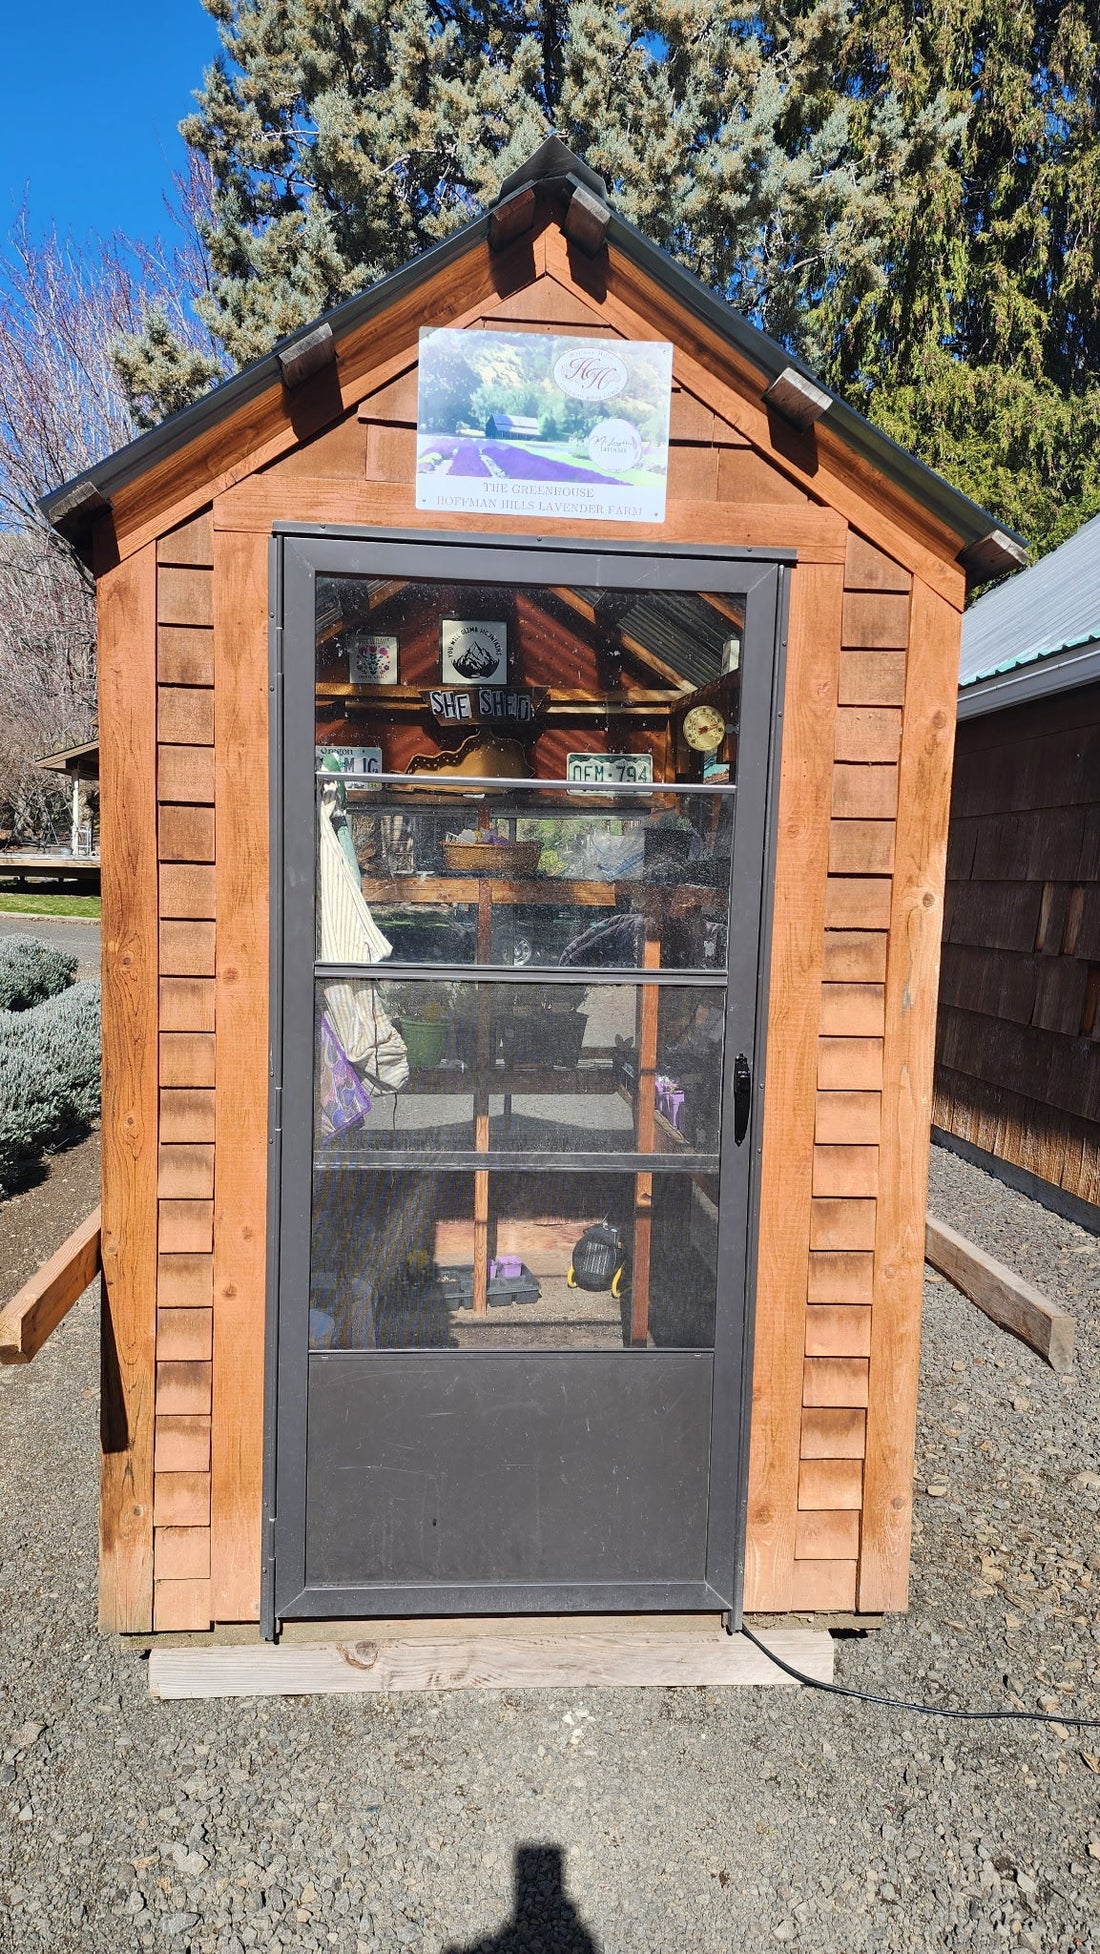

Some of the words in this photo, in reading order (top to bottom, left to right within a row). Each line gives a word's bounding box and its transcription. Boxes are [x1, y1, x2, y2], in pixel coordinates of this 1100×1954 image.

[482, 482, 508, 494] THE
[512, 485, 595, 498] GREENHOUSE
[437, 495, 497, 509] HOFFMAN
[501, 499, 535, 511] HILLS
[539, 501, 604, 515] LAVENDER
[608, 505, 643, 517] FARM
[431, 691, 471, 720] SHE
[480, 690, 529, 720] SHED
[321, 747, 354, 756] Oregon
